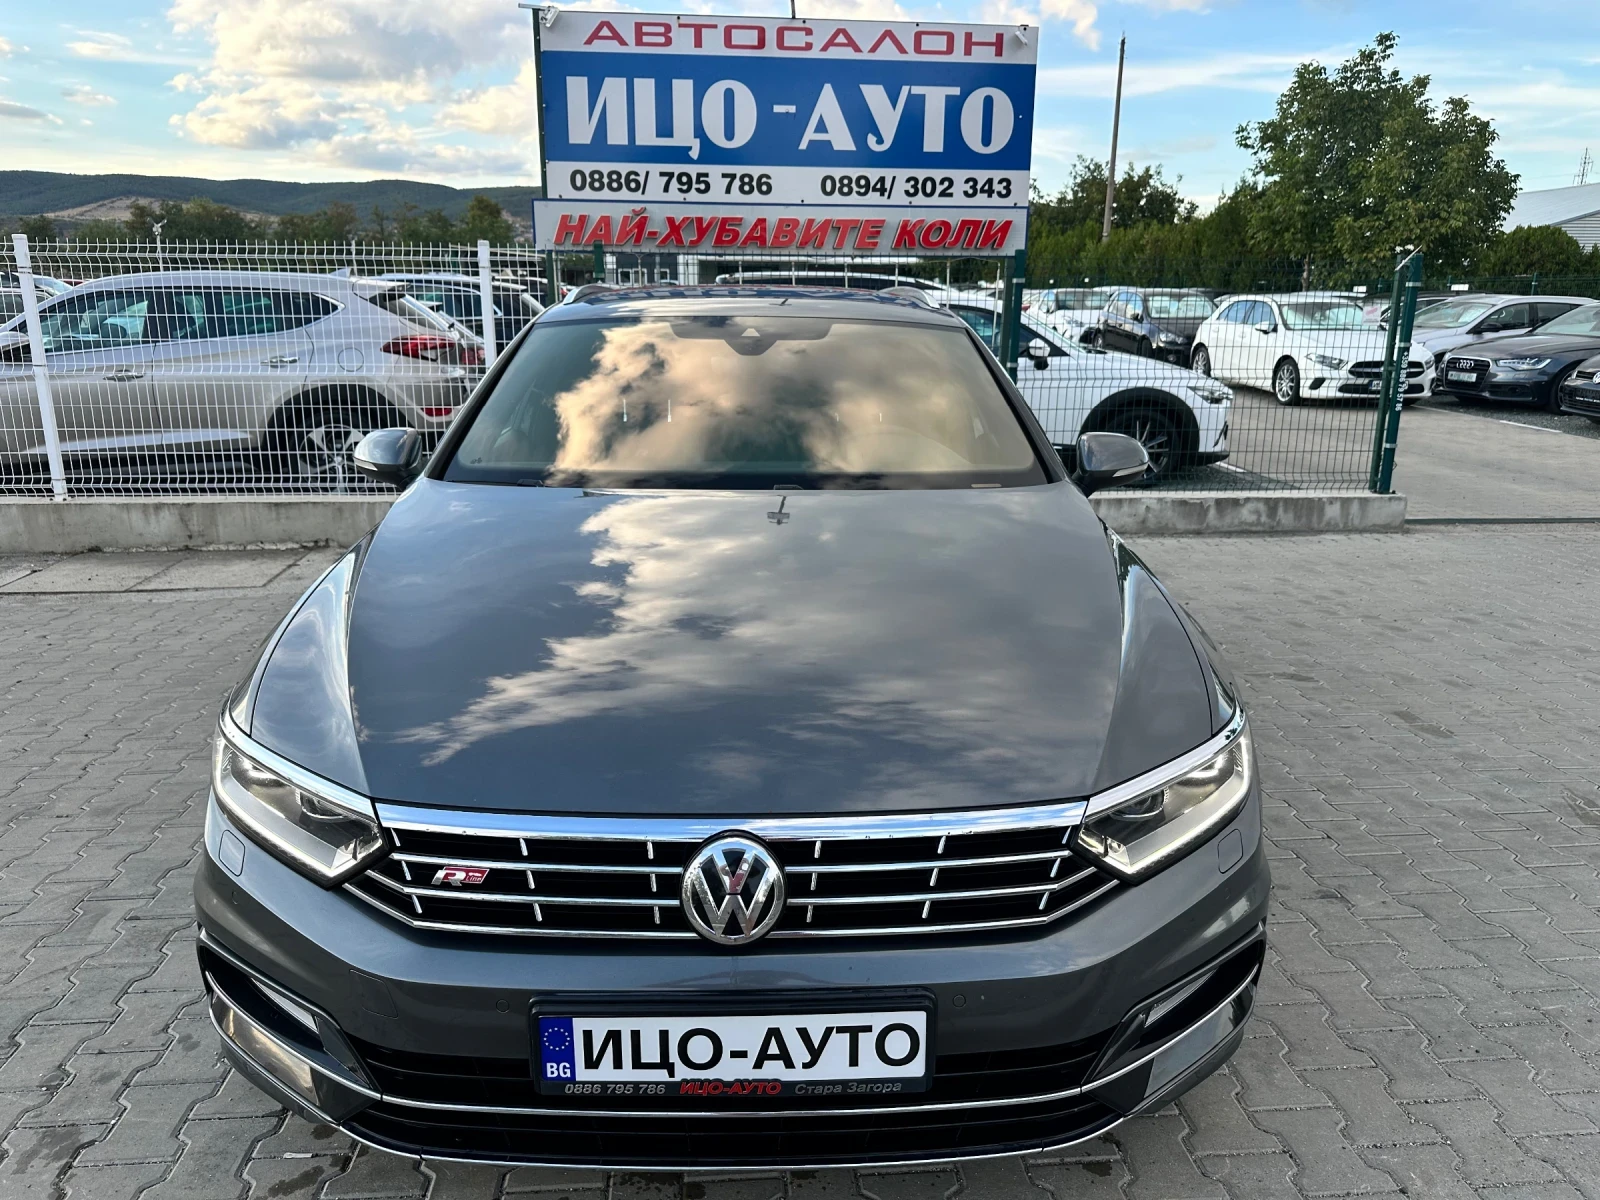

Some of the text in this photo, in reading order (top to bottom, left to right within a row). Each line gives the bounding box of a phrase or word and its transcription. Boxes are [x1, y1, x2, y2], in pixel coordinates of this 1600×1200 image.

[583, 20, 1004, 57] АВТОСАЛОН
[569, 169, 773, 196] 0886/ 795 786
[820, 175, 1013, 199] 0894/ 302 343
[553, 207, 1014, 250] НАЙ-ХУБАВИТЕ КОЛИ
[581, 1022, 921, 1078] ИЦО-АУТО
[546, 1062, 571, 1078] BG
[564, 1083, 666, 1095] 0886 795 786
[679, 1081, 782, 1096] ИЦО-АУТО
[794, 1081, 902, 1096] Стара Загора
